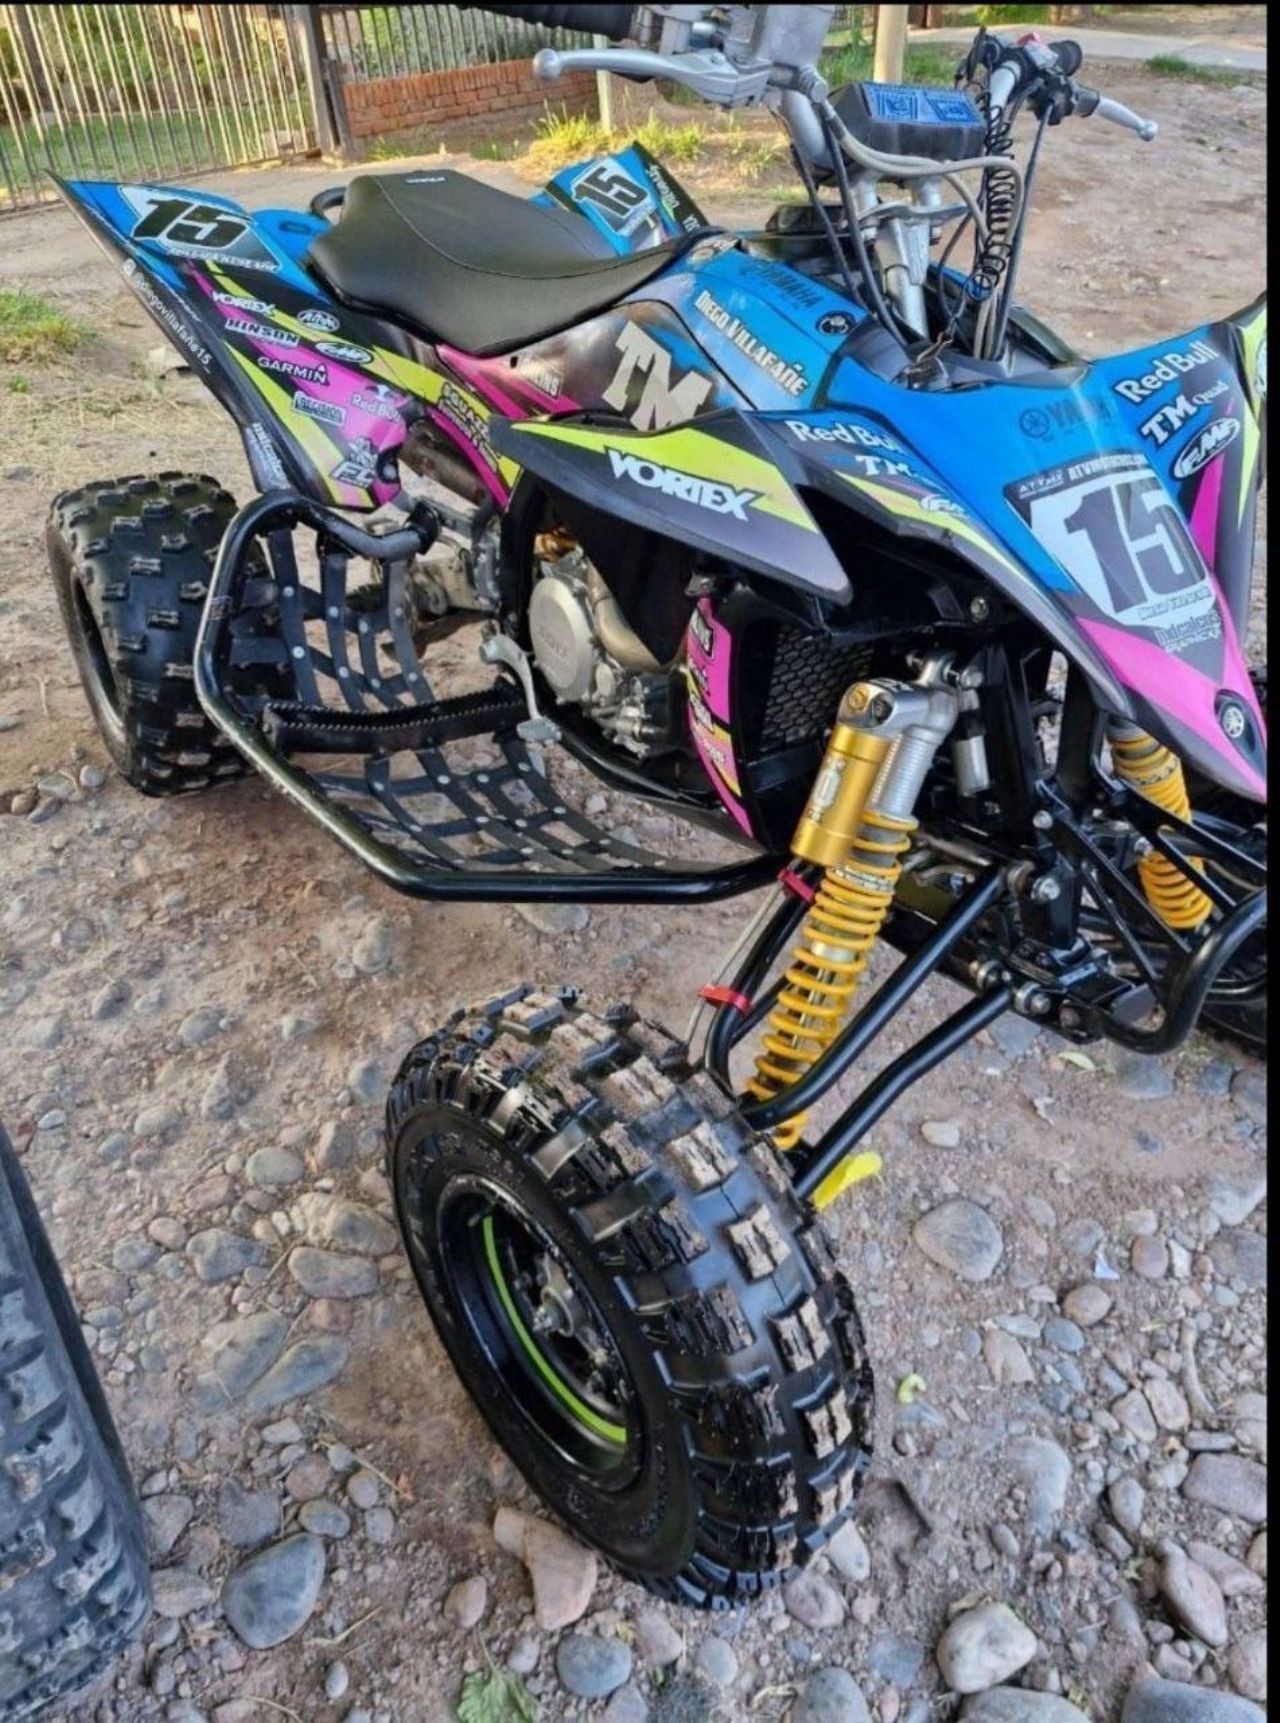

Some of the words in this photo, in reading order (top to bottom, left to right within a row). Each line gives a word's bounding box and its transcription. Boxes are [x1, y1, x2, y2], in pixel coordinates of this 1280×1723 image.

[575, 166, 649, 218] 15
[133, 199, 248, 248] 15
[694, 289, 731, 330] DIEGO
[256, 356, 328, 386] GARMIN
[602, 320, 714, 433] TM
[1114, 358, 1178, 403] Red
[1164, 340, 1219, 373] Bull
[352, 394, 379, 412] Red
[1140, 394, 1197, 445] TM
[1191, 380, 1230, 404] Quad
[785, 419, 853, 443] Red
[604, 448, 758, 522] VORTEX
[1064, 479, 1207, 614] 15
